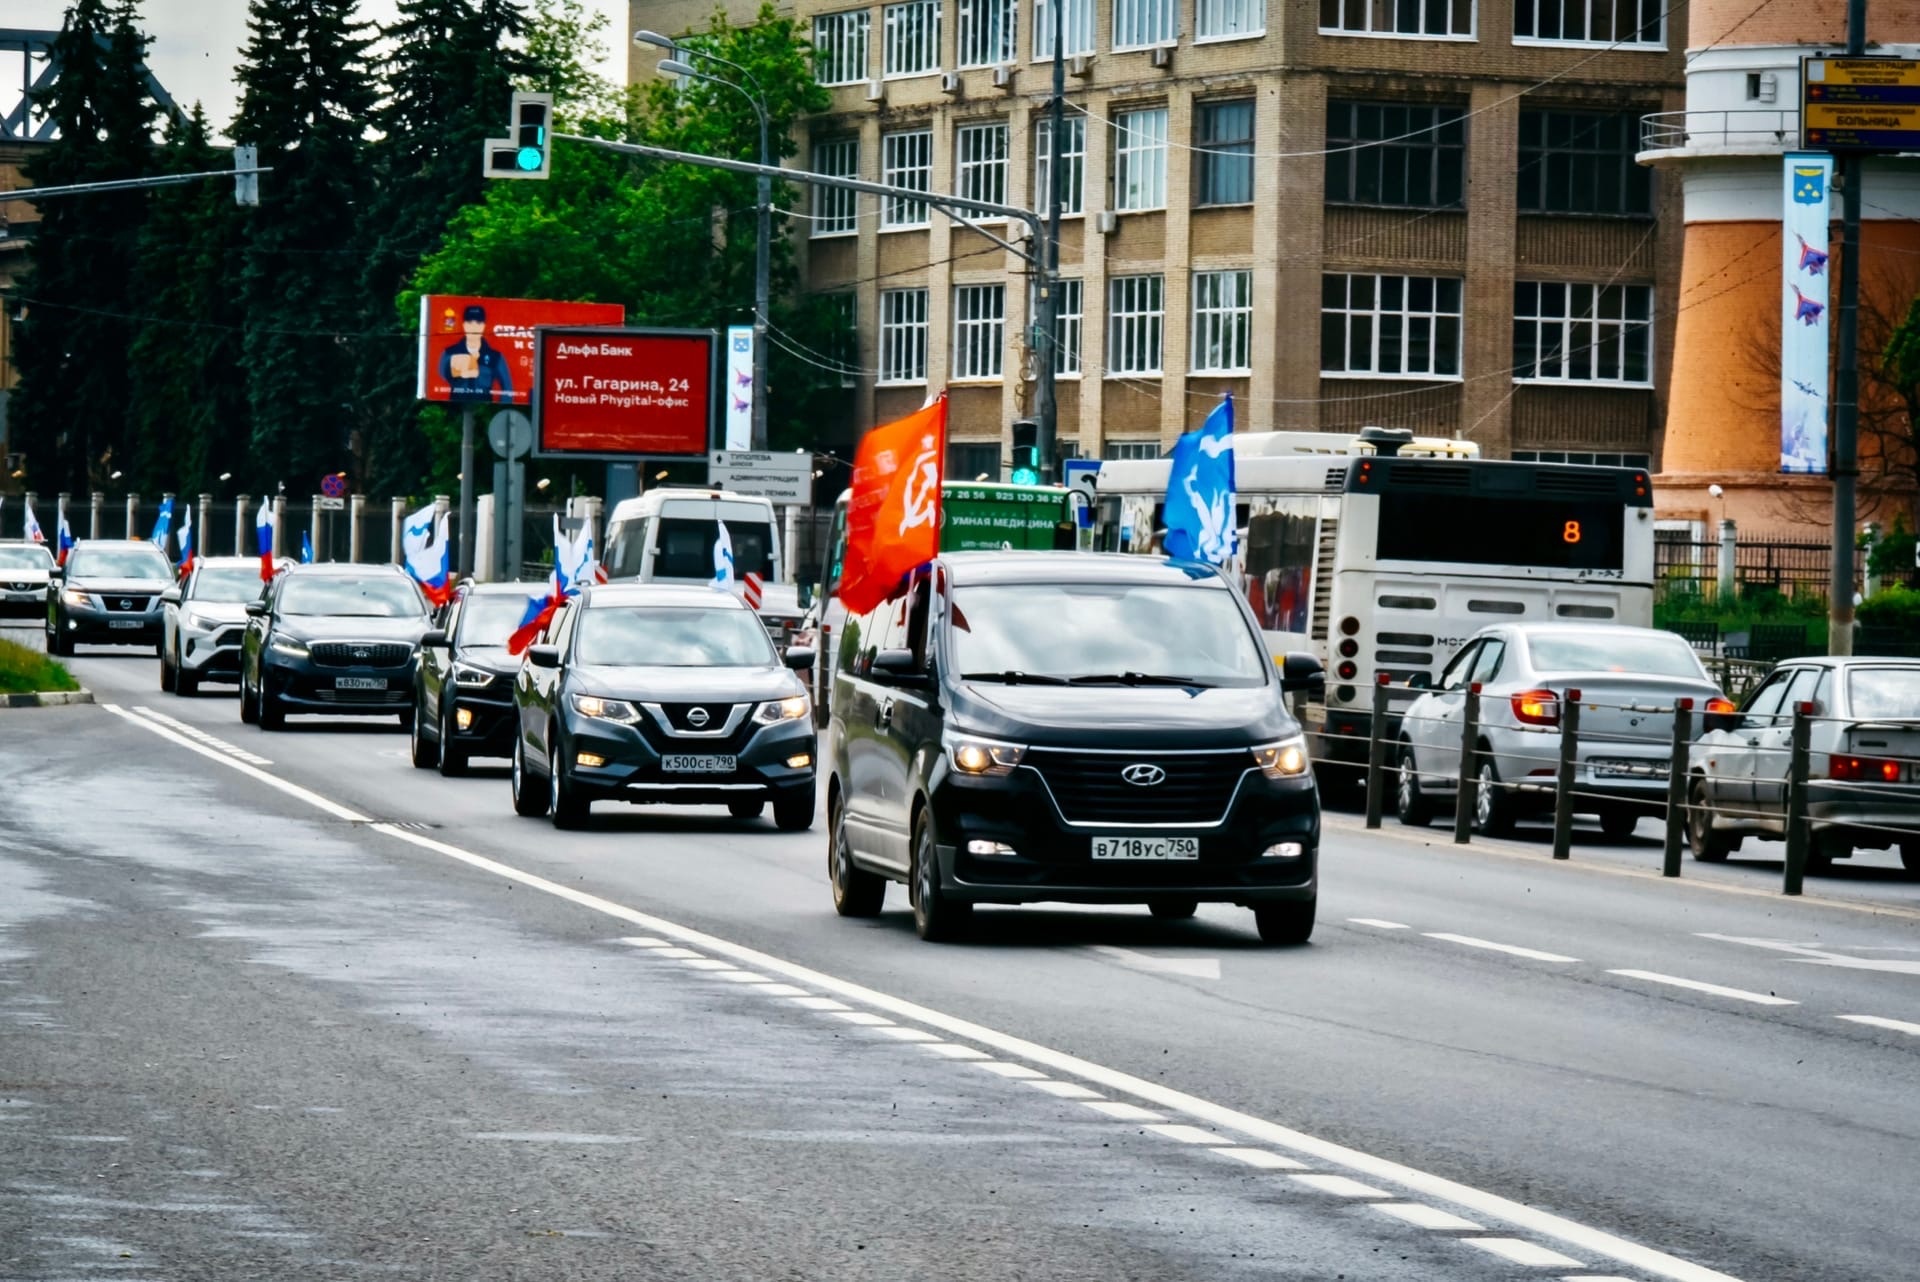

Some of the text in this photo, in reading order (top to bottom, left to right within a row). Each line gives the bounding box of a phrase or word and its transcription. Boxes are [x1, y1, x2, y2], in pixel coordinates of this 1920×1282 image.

[1836, 116, 1901, 127] БОЛЬНИЦА
[557, 342, 632, 358] Альфа Банк
[554, 376, 690, 393] ул. Гагарина, 24
[554, 392, 689, 409] Новый Phygital-офис
[729, 474, 799, 483] АДМИНИСТРАЦИЯ
[995, 492, 1014, 501] 925
[1017, 493, 1034, 502] 130
[952, 516, 1054, 529] УМНАЯ МЕДИЦИНА
[1562, 520, 1581, 544] 8
